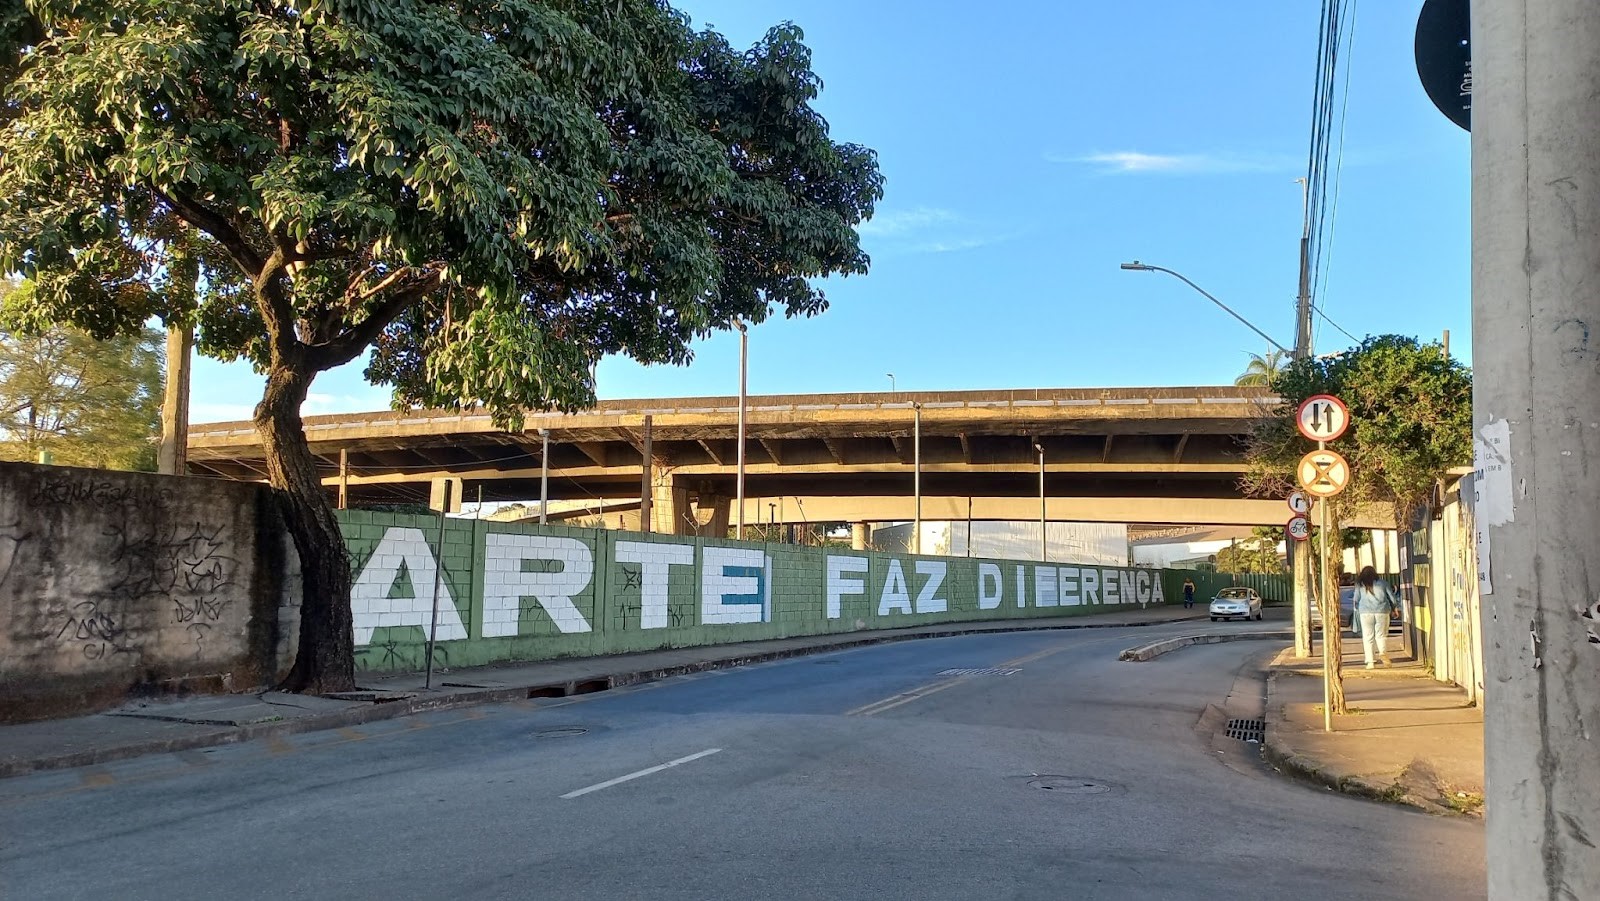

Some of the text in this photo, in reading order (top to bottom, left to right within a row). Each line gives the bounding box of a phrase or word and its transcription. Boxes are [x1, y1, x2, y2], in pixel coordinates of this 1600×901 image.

[351, 526, 768, 647] ARTE
[826, 555, 949, 619] FAZ
[978, 563, 1165, 609] DIFERENÇA
